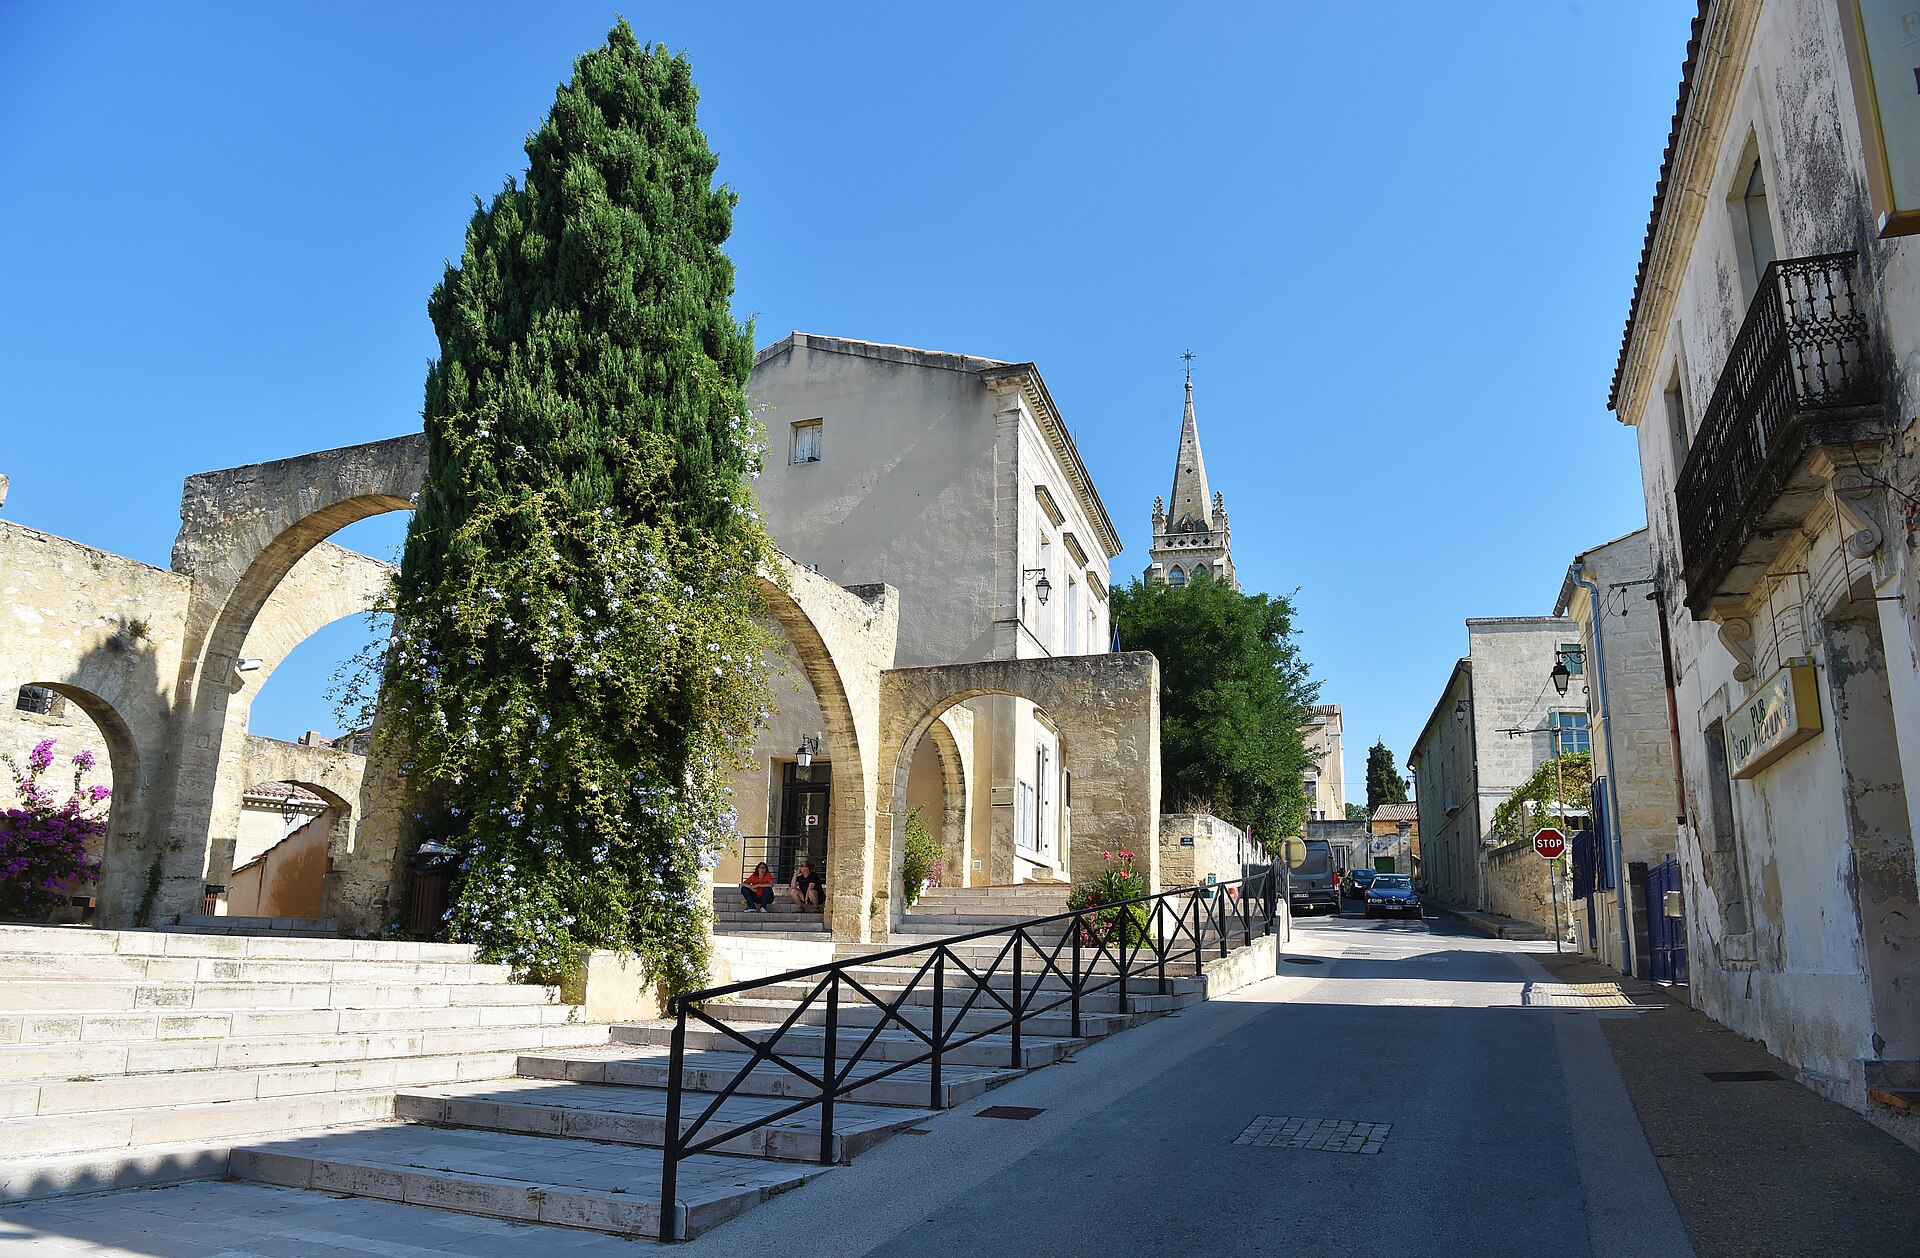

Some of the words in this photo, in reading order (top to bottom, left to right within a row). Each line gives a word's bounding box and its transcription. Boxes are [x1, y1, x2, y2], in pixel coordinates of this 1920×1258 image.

[1750, 699, 1766, 728] PUB
[1740, 734, 1752, 760] DU
[1752, 707, 1784, 748] MOULIN
[1537, 839, 1562, 848] STOP
